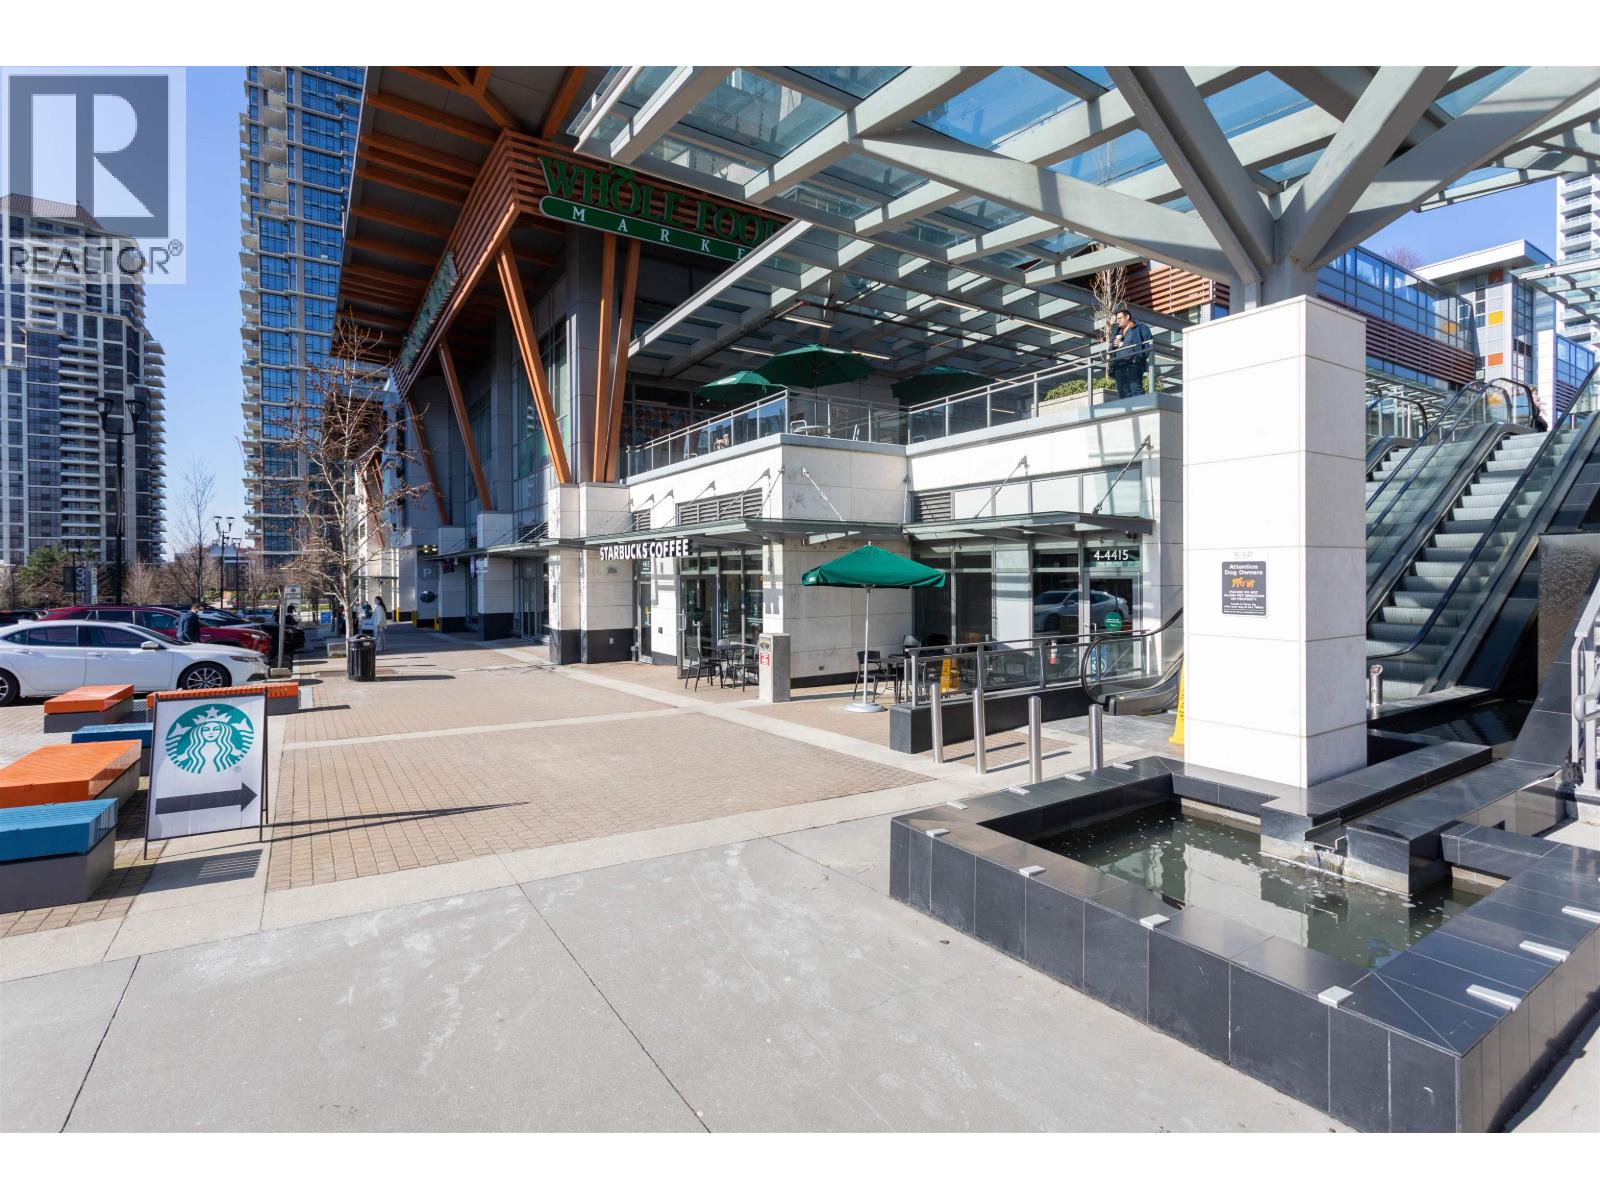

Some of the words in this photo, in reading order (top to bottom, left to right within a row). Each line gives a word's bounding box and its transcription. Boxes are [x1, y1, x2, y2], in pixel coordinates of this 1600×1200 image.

[538, 156, 686, 226] WHOLE
[600, 543, 647, 560] STARBUCKS
[650, 539, 689, 558] COFFEE
[1093, 550, 1129, 560] 4-4415
[75, 567, 86, 592] SOLO
[423, 568, 431, 578] P
